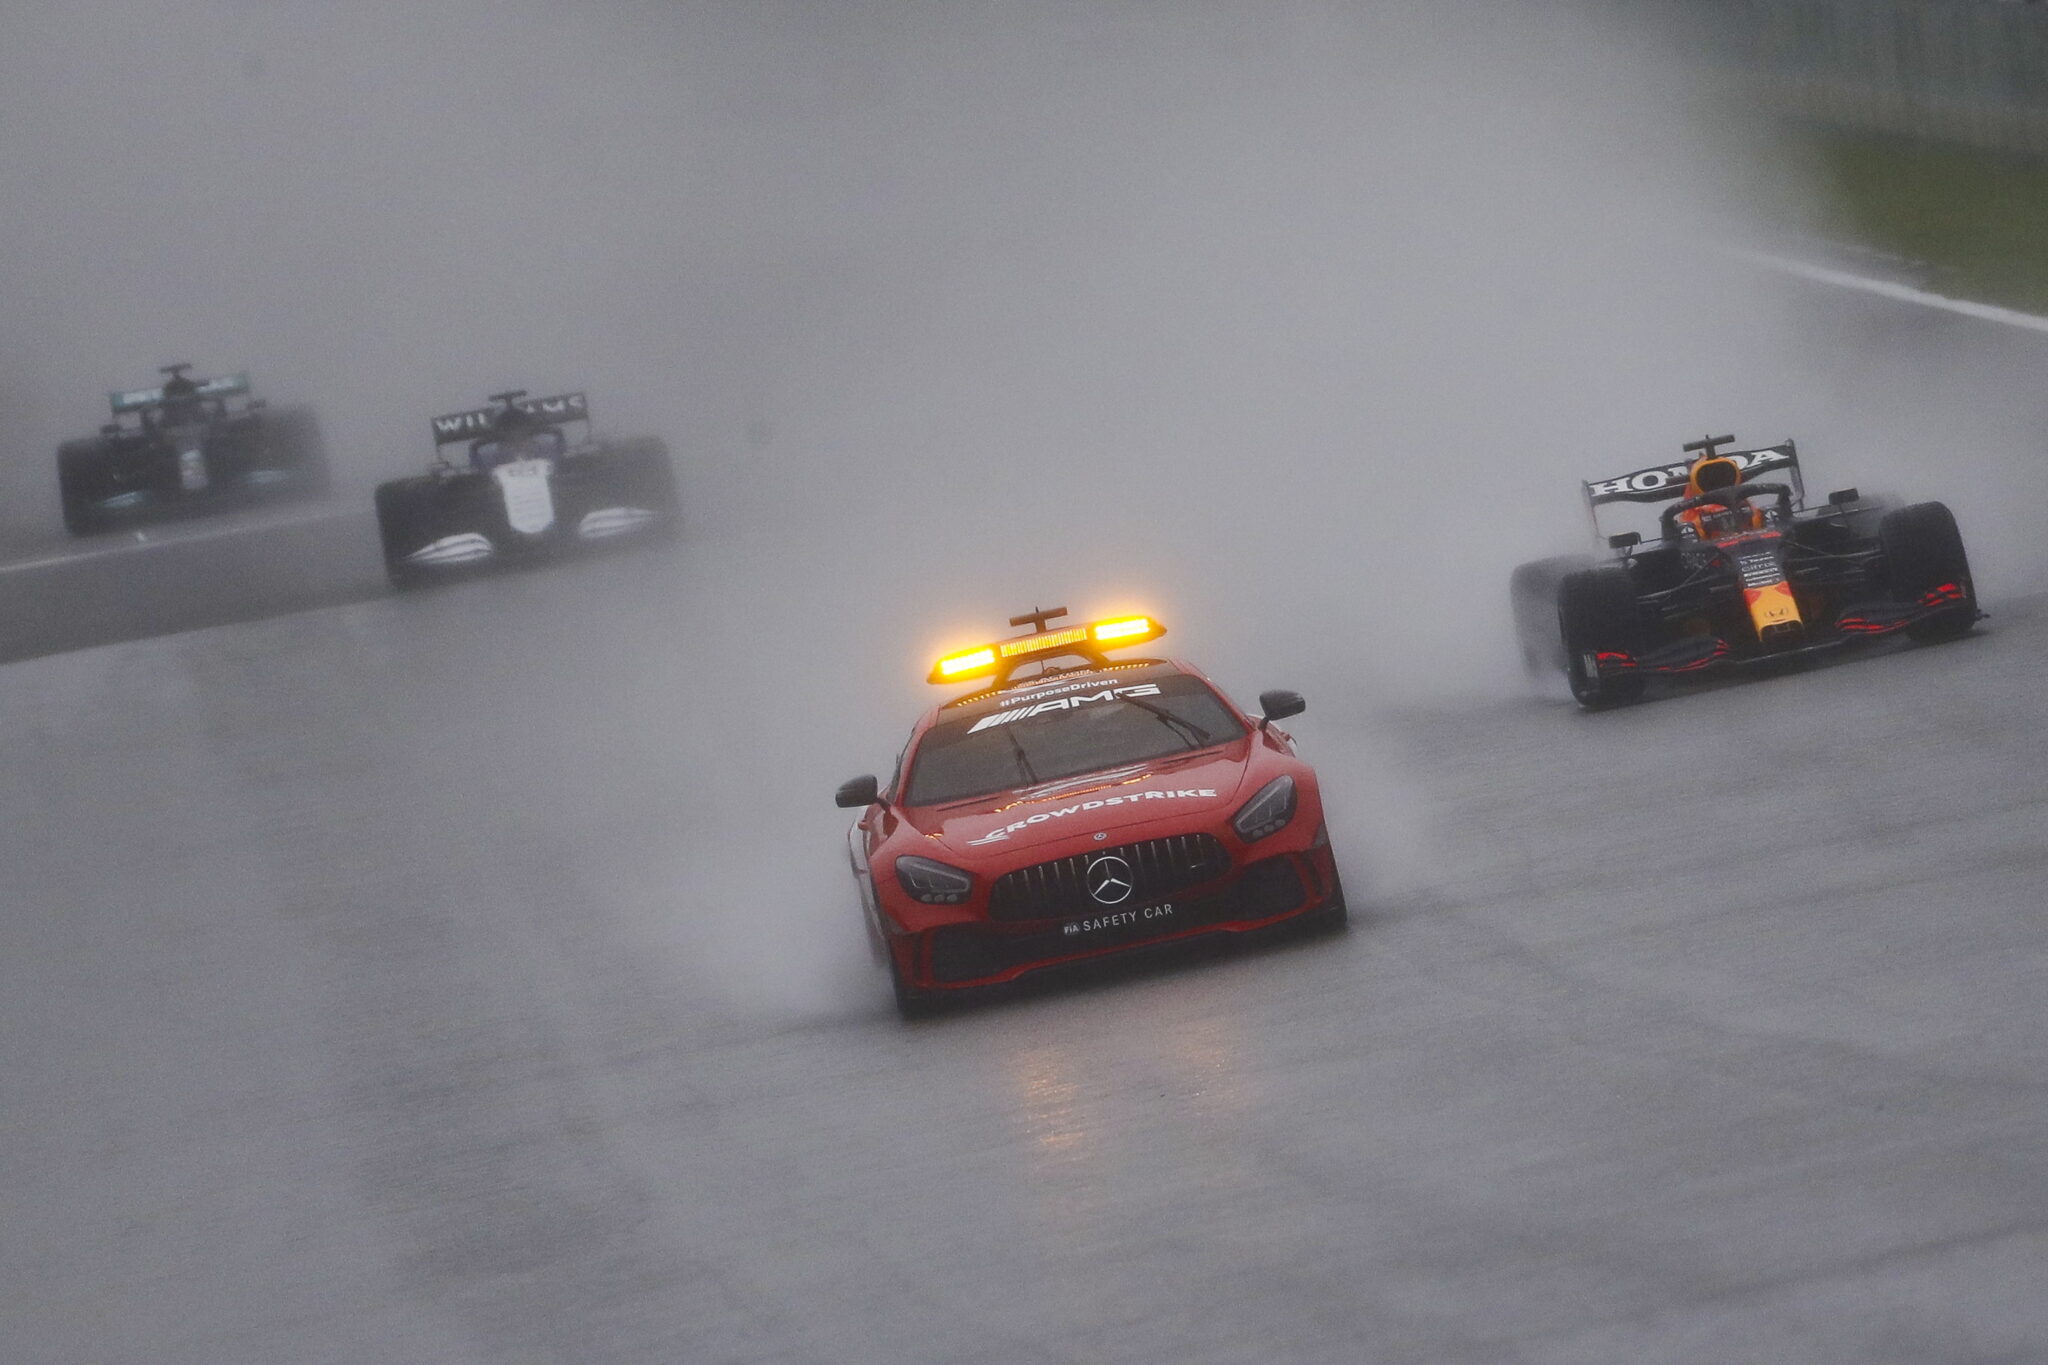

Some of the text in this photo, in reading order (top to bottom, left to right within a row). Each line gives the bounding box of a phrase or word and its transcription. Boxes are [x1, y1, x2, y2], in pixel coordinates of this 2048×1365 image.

[1000, 679, 1119, 707] #PurposeDriven
[968, 789, 1217, 846] CROWDSTRIKE
[1063, 904, 1173, 935] FIA SAFETY CAR
